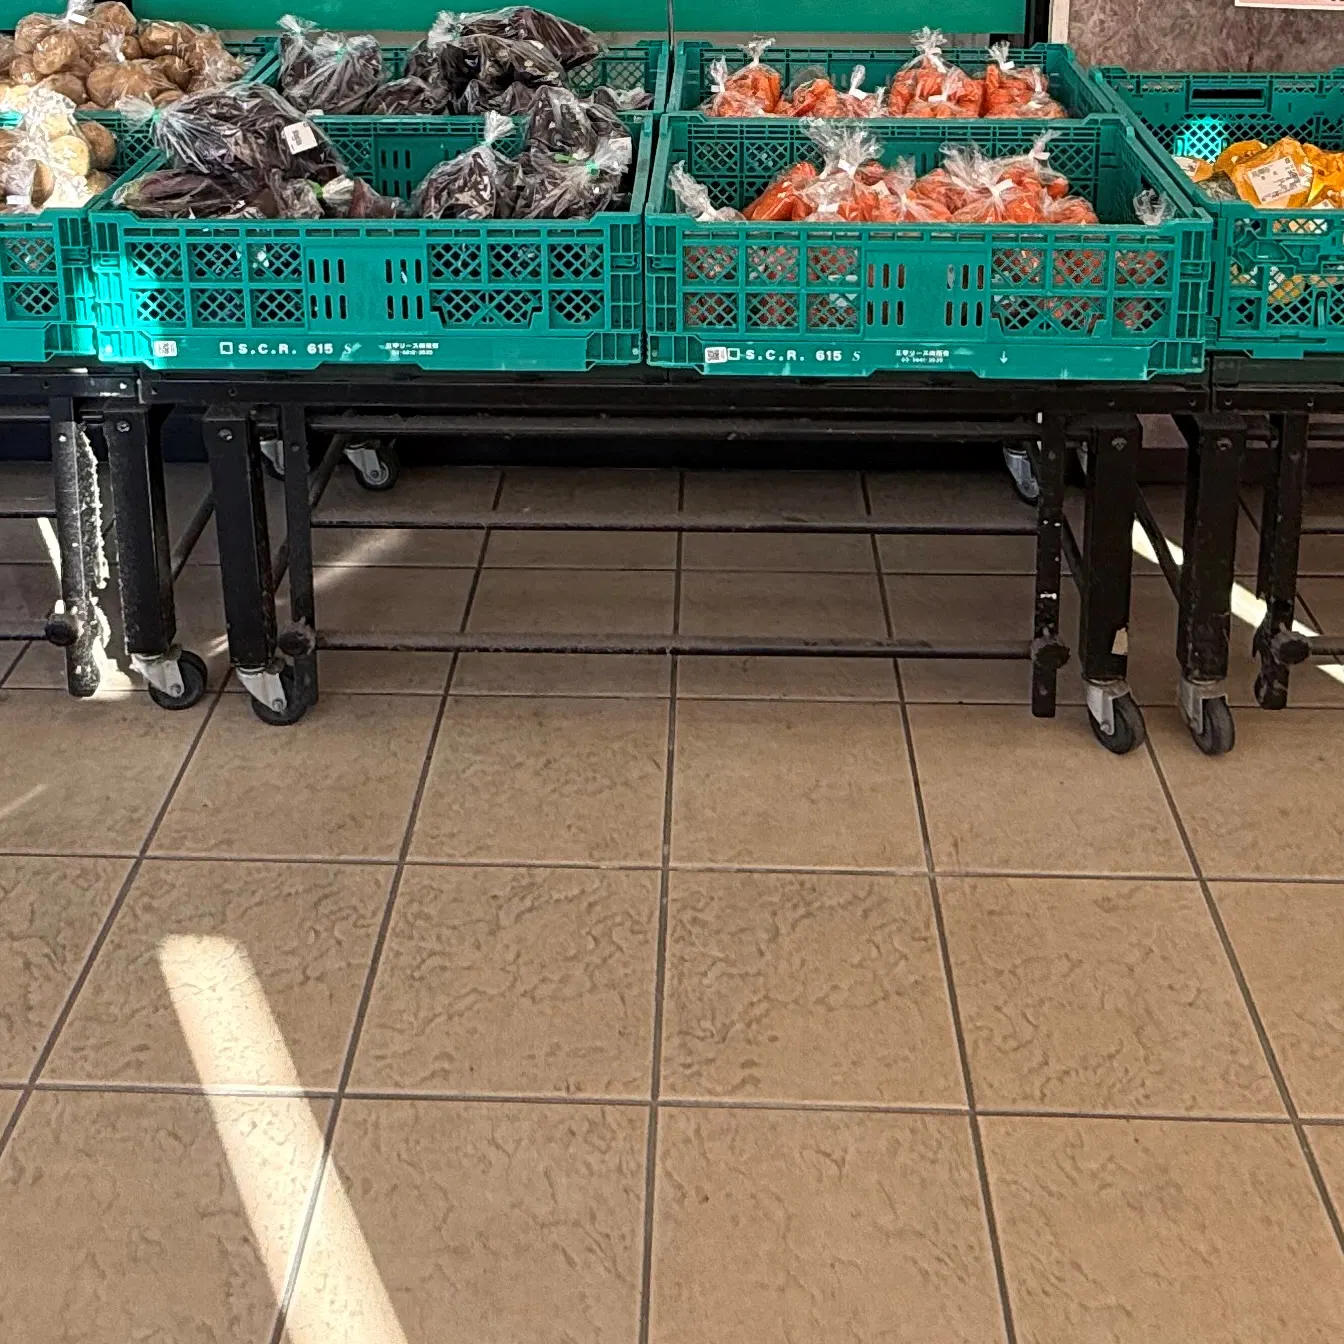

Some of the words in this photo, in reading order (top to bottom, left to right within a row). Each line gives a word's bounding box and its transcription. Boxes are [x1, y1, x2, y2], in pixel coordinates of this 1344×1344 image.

[238, 343, 297, 355] S.C.R.
[307, 343, 334, 355] 615
[745, 349, 805, 362] S.C.R.
[815, 350, 843, 362] 615
